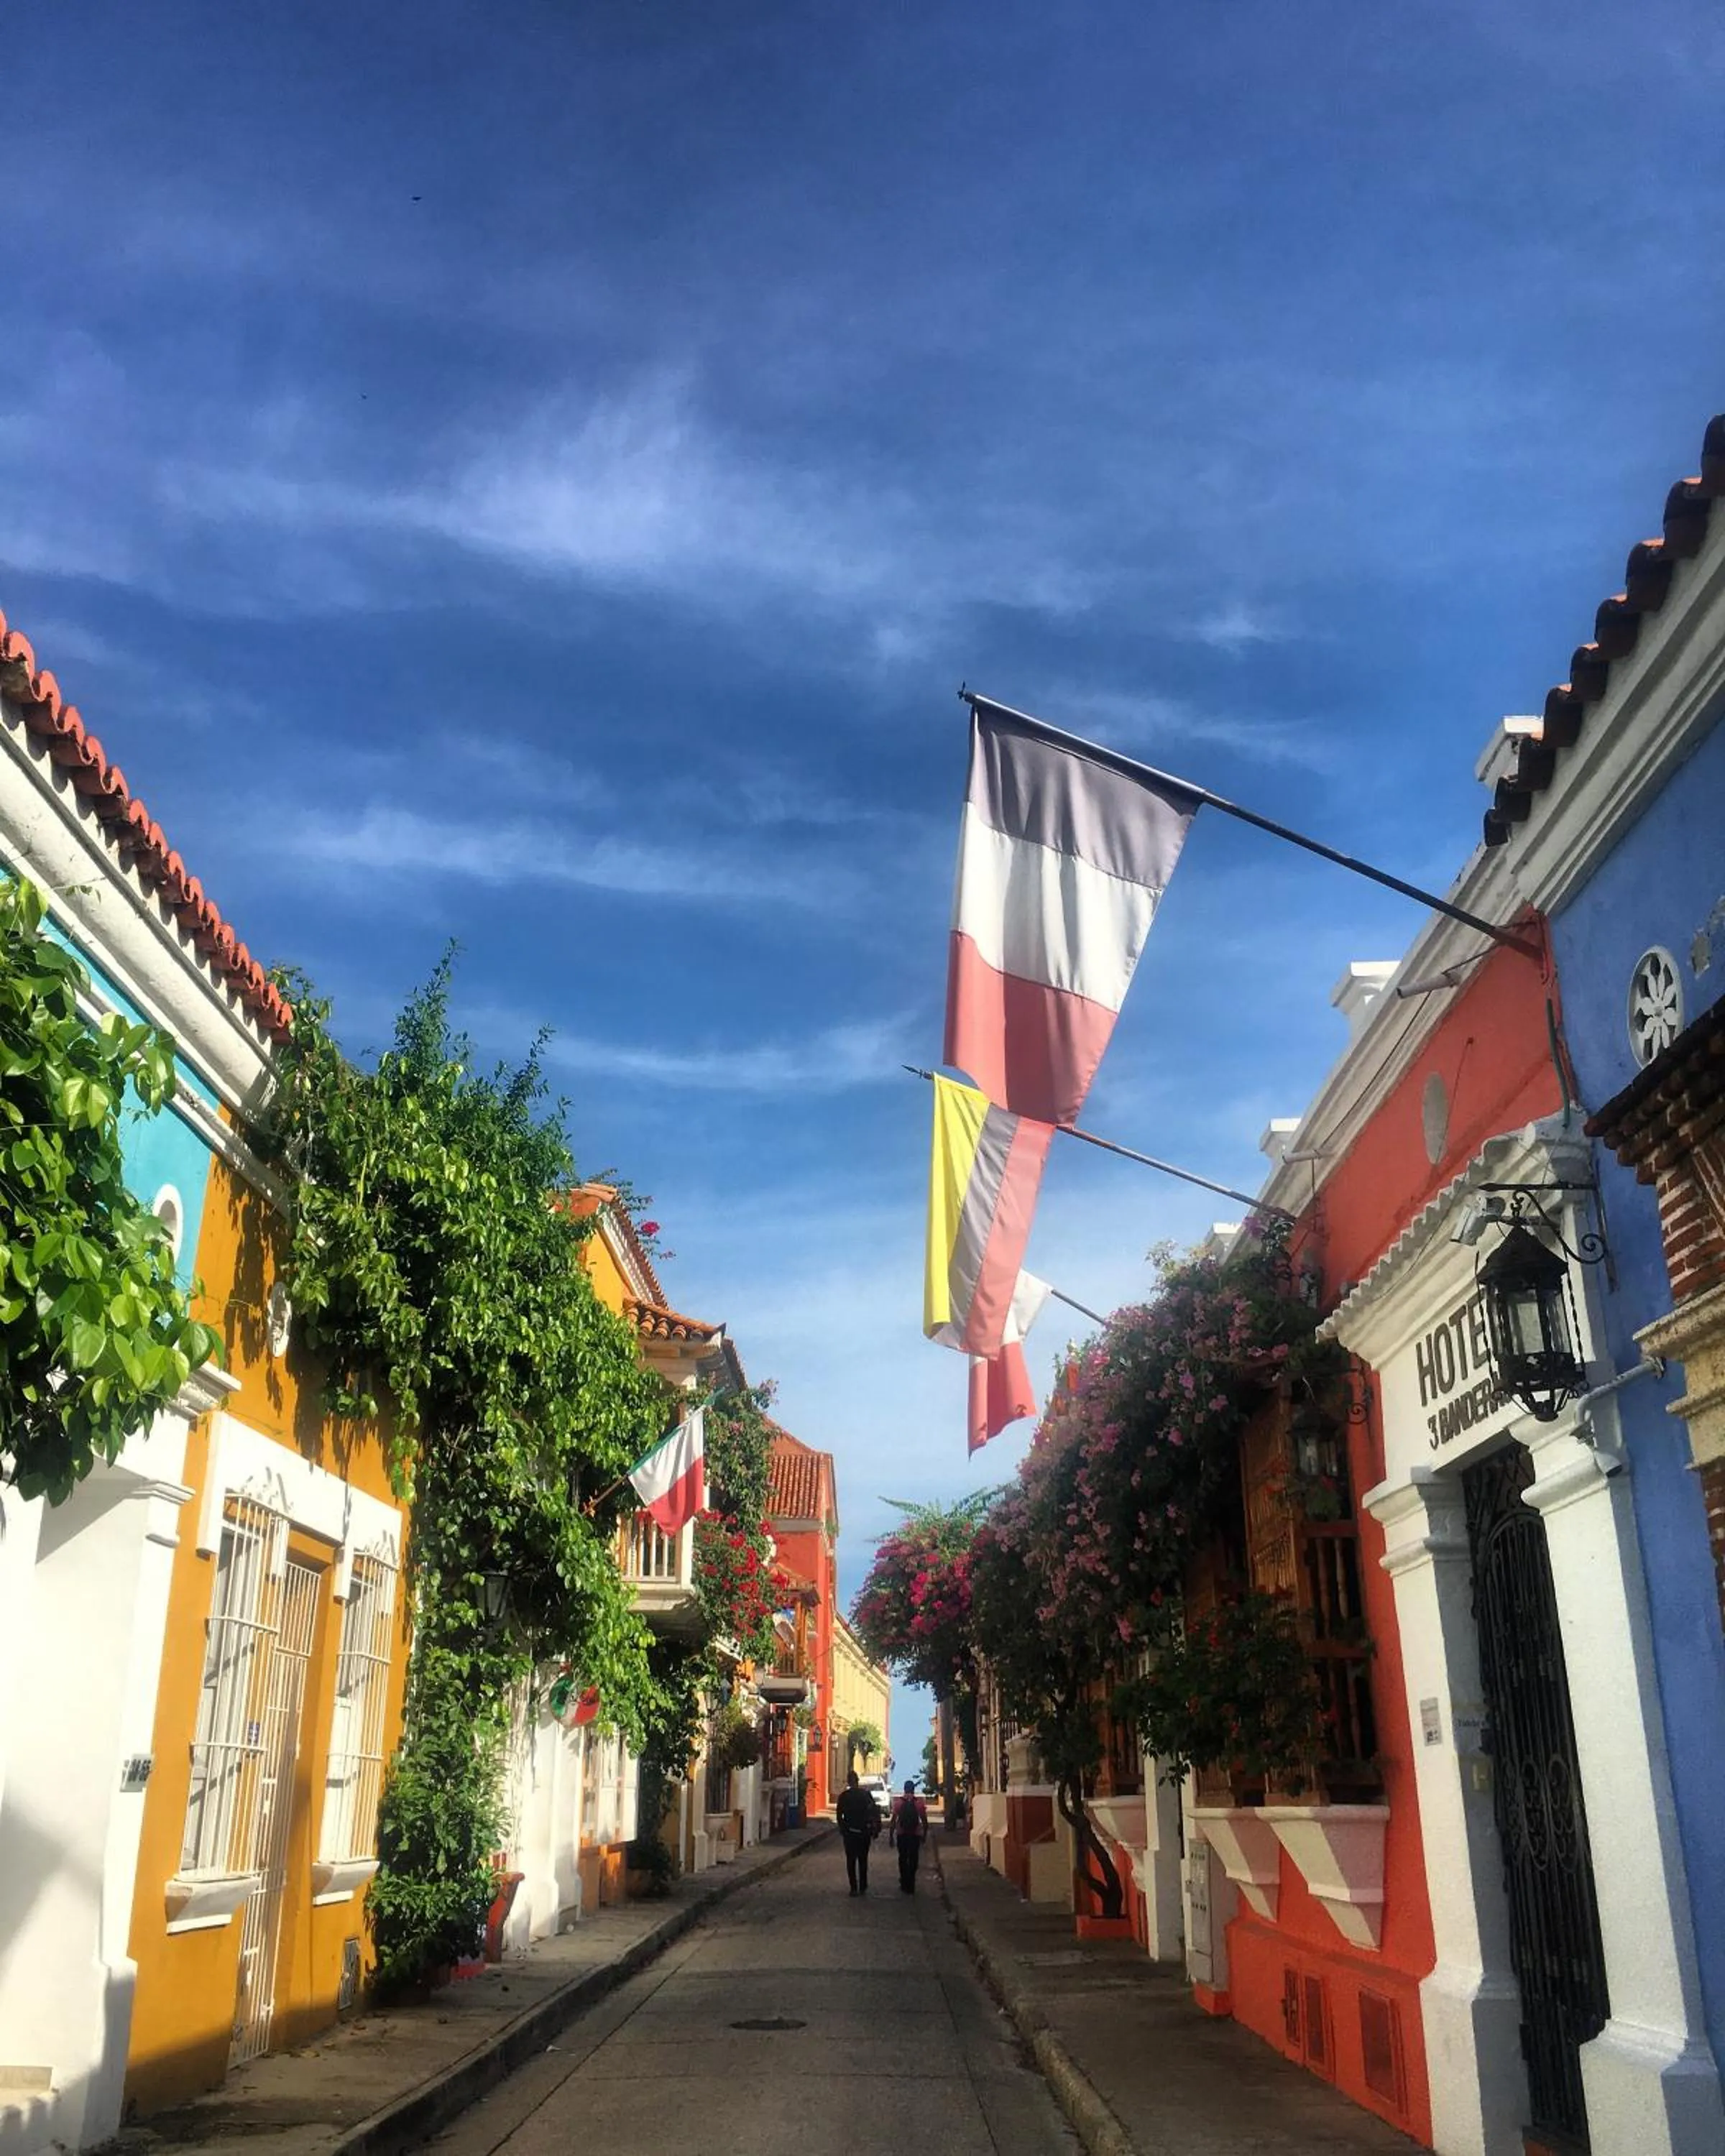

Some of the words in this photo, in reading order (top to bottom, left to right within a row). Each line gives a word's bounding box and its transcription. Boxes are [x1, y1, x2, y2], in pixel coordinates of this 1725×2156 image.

[1415, 1287, 1491, 1406] HOTE
[1427, 1414, 1439, 1450] 3
[1439, 1371, 1512, 1445] BANDER
